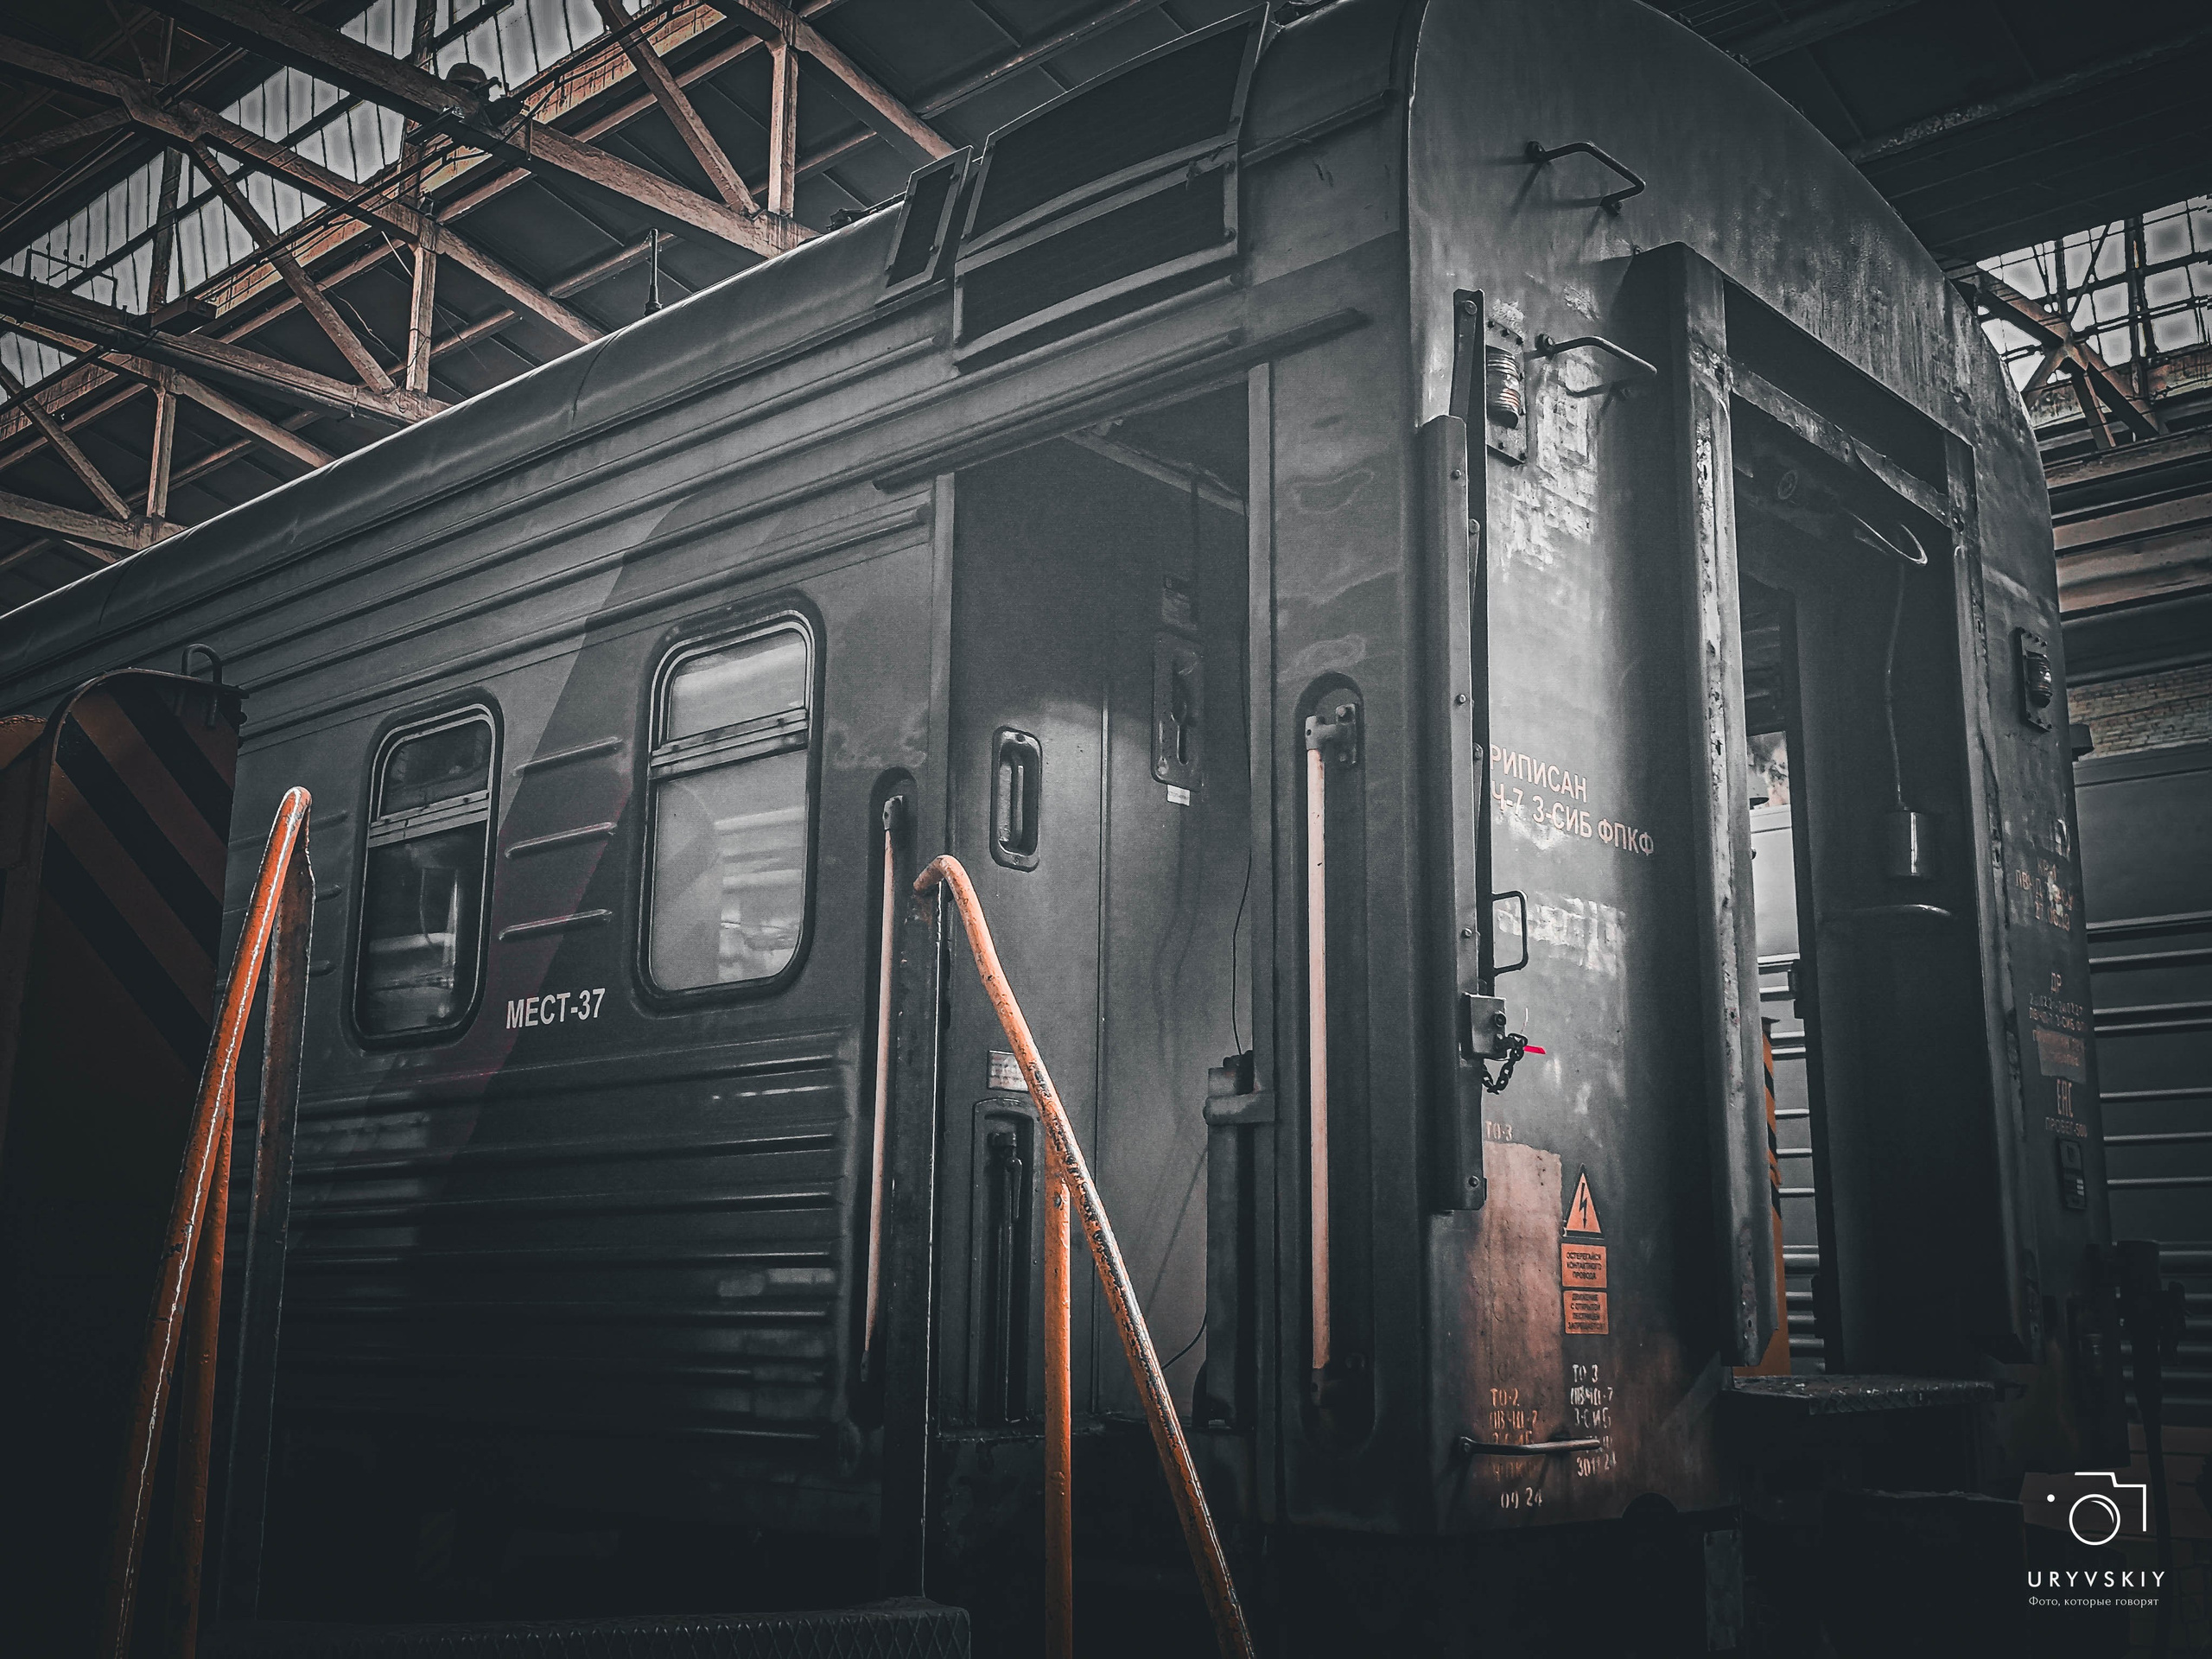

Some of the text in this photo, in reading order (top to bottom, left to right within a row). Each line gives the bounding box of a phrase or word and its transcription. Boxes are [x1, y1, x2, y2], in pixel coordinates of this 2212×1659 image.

[1491, 743, 1586, 803] РИПИСАН
[1491, 779, 1654, 855] Ч-7 З-СИБ ФПКФ
[505, 988, 606, 1029] МЕСТ-37
